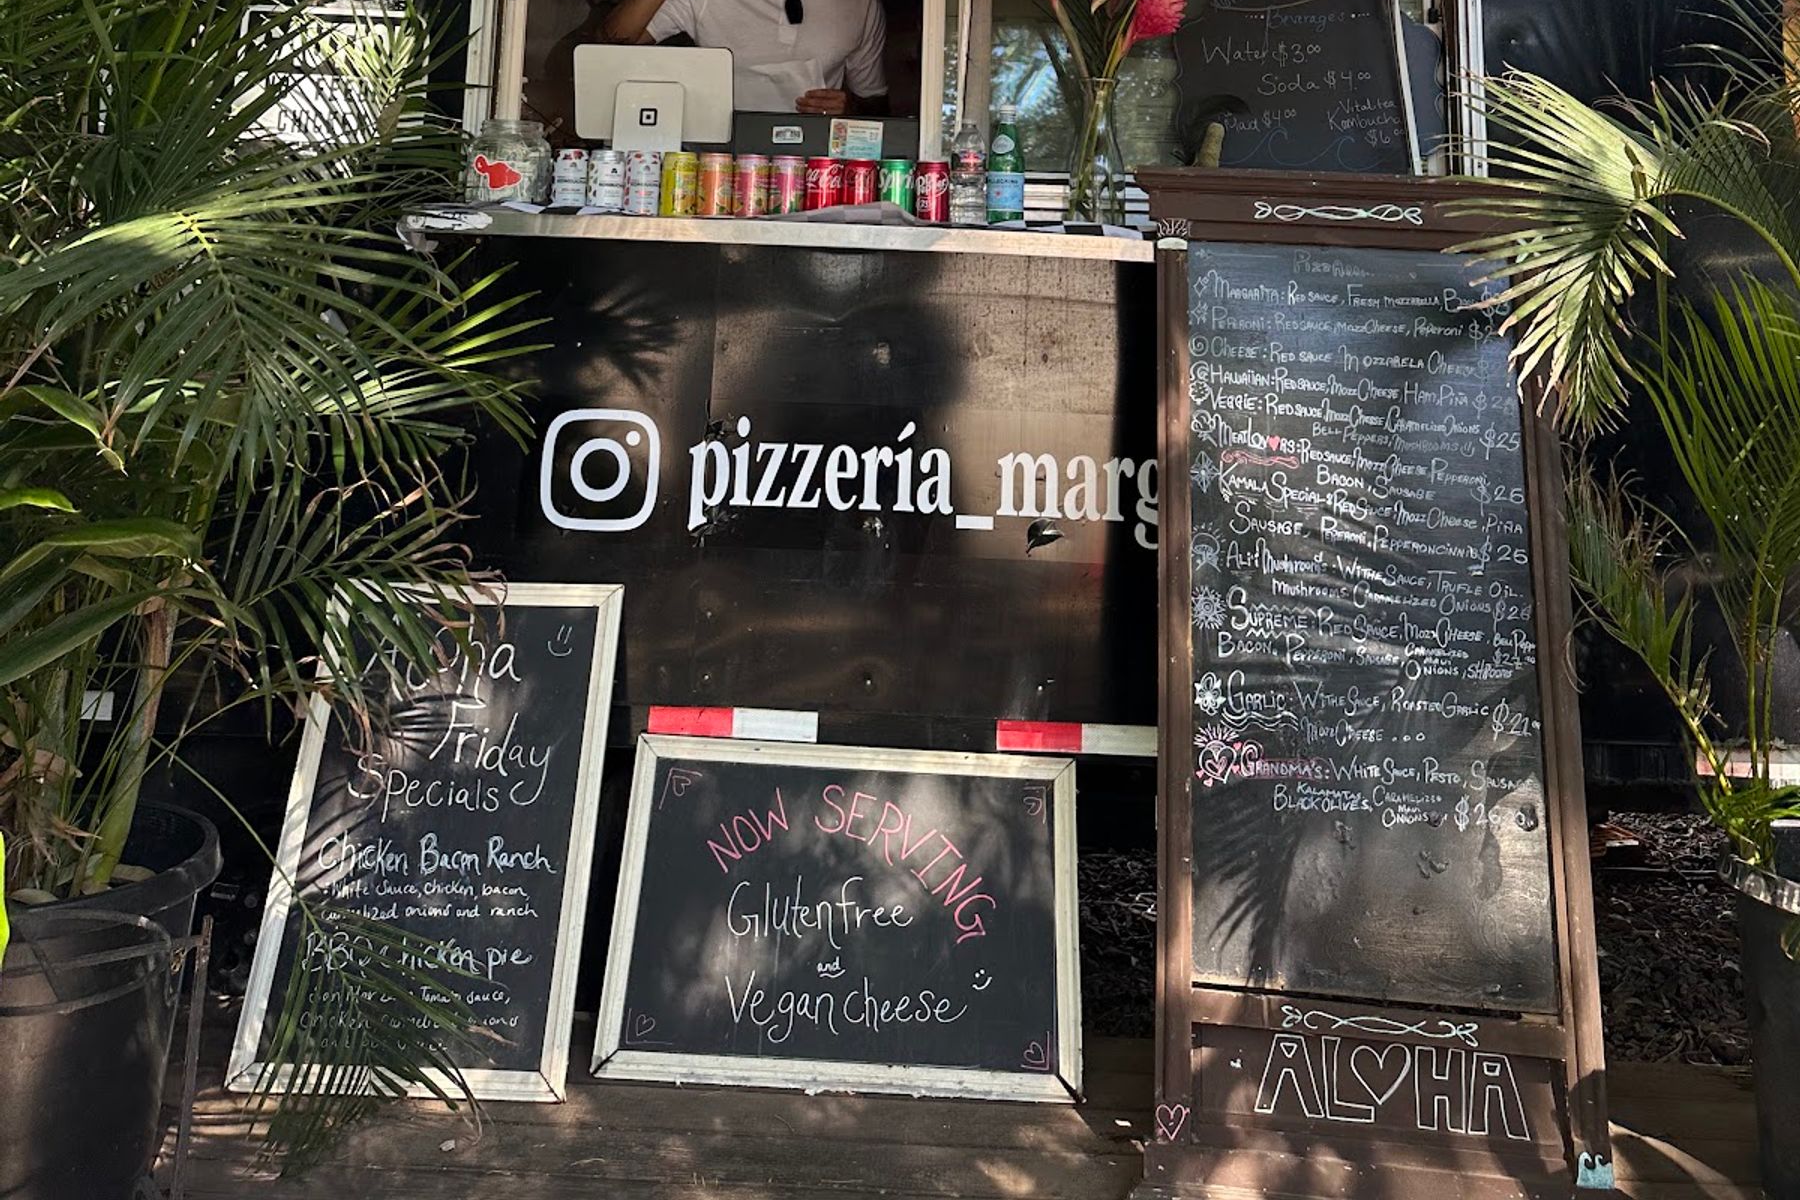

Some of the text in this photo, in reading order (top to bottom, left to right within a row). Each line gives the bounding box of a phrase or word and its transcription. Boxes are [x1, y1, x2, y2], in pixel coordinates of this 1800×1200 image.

[1201, 37, 1266, 65] Water
[1257, 73, 1320, 96] Soda
[429, 701, 551, 806] Friday
[348, 754, 500, 824] Specials
[318, 831, 557, 876] Chicken Bacon Ranch
[707, 784, 997, 945] NOW SERVING
[456, 904, 482, 919] and
[490, 904, 538, 919] ranch
[726, 874, 916, 950] Gluten free
[486, 943, 532, 981] pie
[816, 956, 846, 973] and
[724, 969, 968, 1044] Vegan cheese
